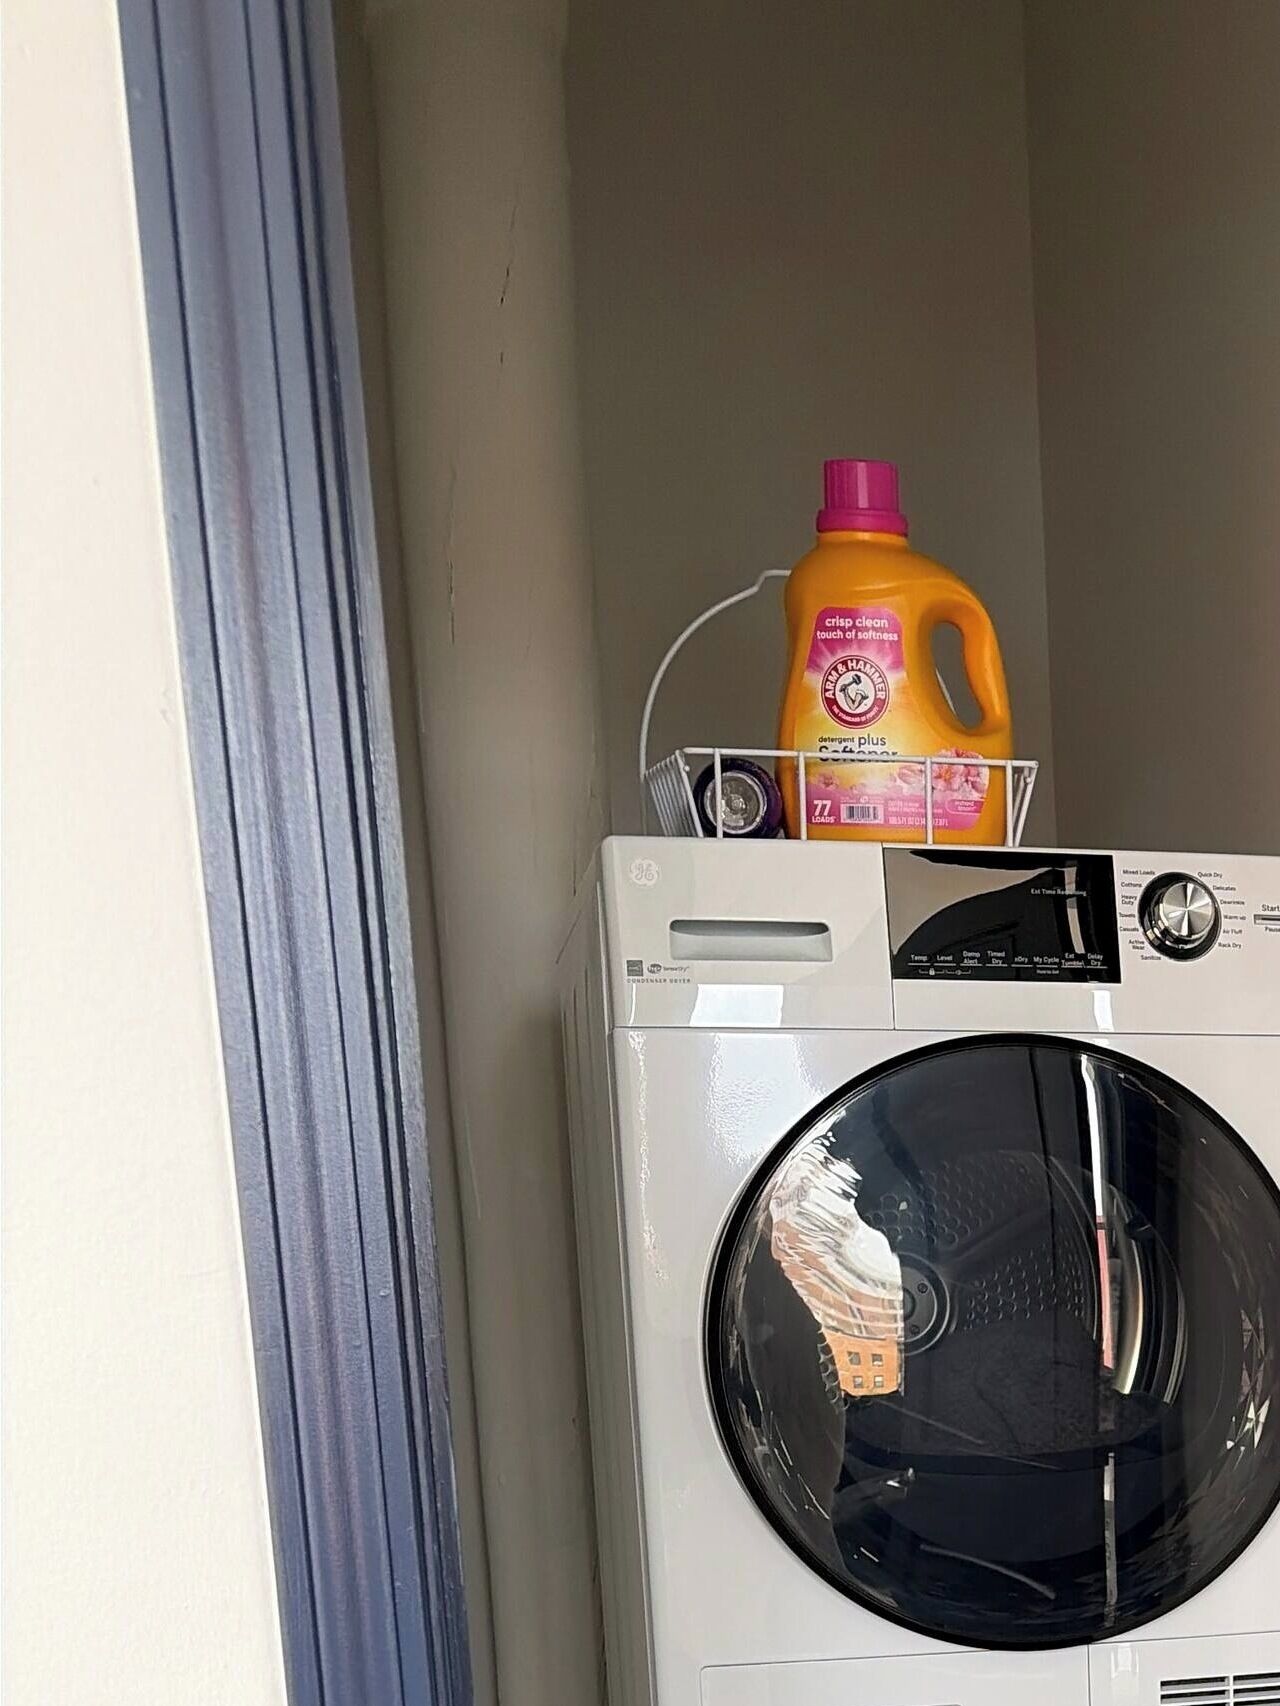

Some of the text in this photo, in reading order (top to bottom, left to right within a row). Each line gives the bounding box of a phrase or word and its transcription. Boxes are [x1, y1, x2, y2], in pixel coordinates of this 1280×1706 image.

[825, 616, 889, 628] crisp clean
[817, 629, 898, 641] touch of softness
[825, 659, 886, 699] ARM & HAMMER
[818, 733, 887, 748] detergent plus
[813, 800, 832, 816] 77
[1262, 904, 1280, 912] Start
